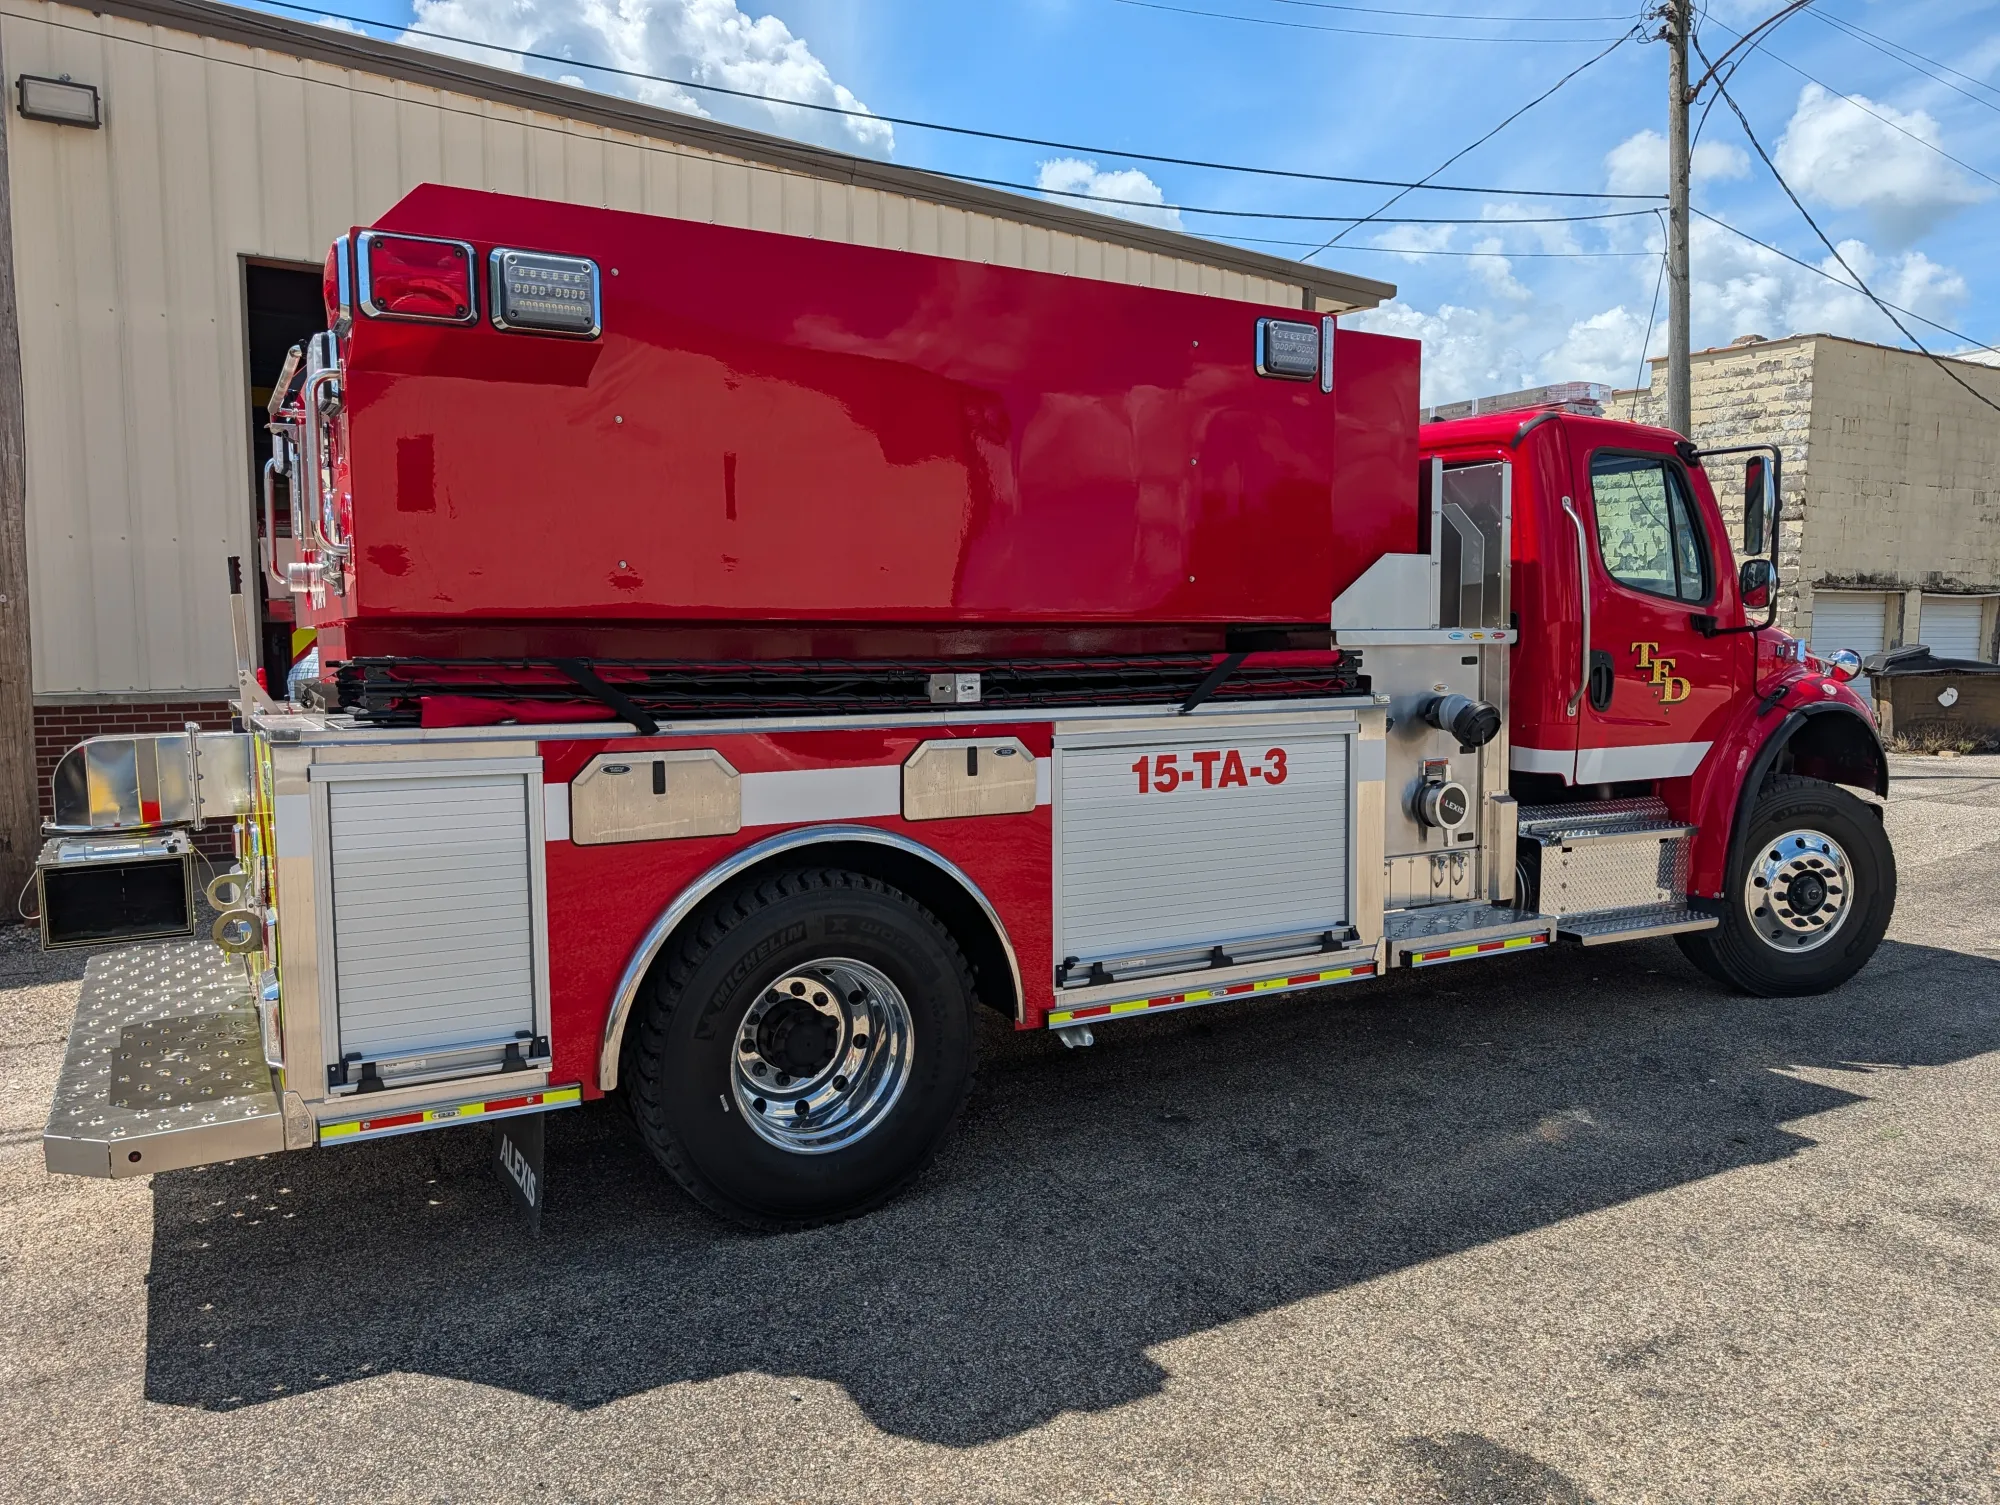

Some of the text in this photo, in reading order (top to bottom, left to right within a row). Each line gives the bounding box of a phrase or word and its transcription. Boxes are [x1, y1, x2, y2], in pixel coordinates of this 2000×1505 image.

[1132, 747, 1288, 794] 15-TA-3
[712, 923, 805, 1008] MICHELIN
[499, 1132, 537, 1208] ALEXIS
